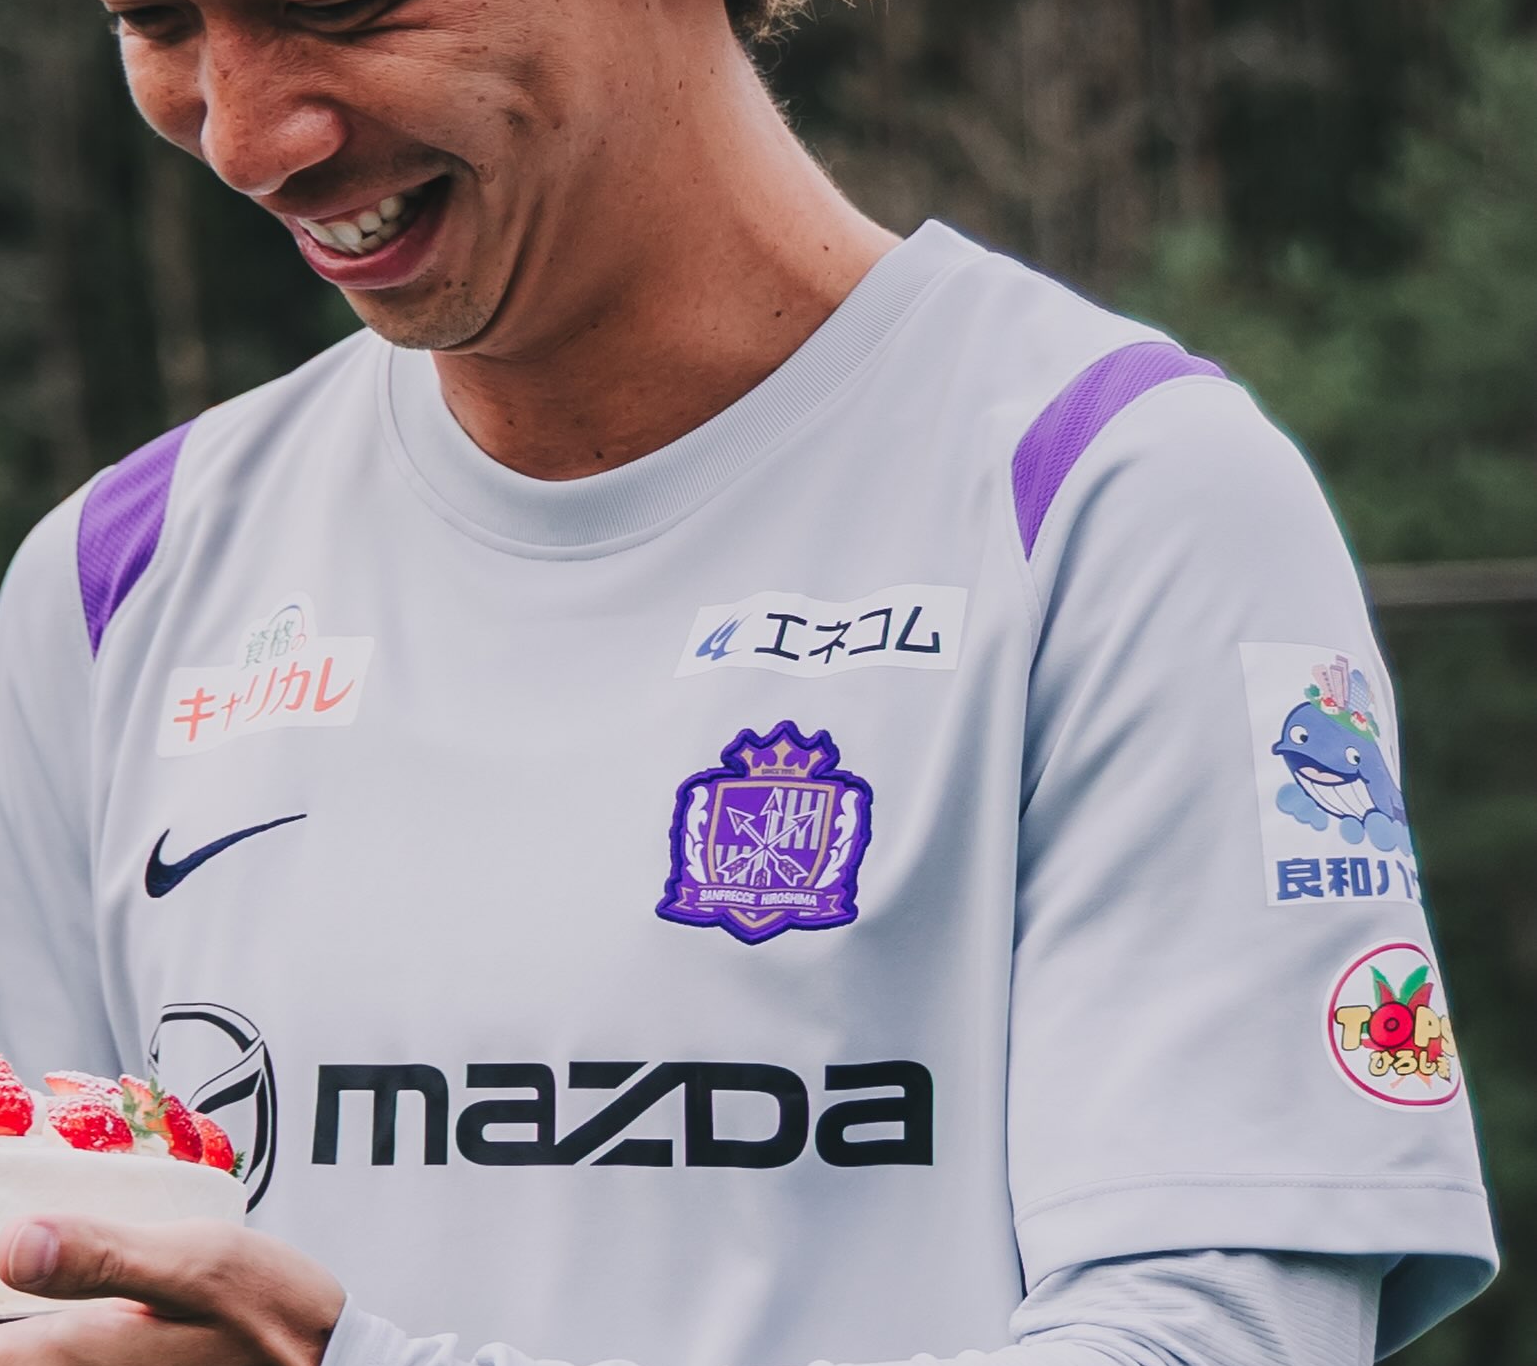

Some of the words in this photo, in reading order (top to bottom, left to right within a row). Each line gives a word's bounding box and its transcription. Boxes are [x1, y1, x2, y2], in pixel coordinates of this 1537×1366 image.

[754, 606, 940, 664] エネコム
[173, 656, 355, 742] キャリカレ
[1276, 857, 1421, 902] 良和ハ
